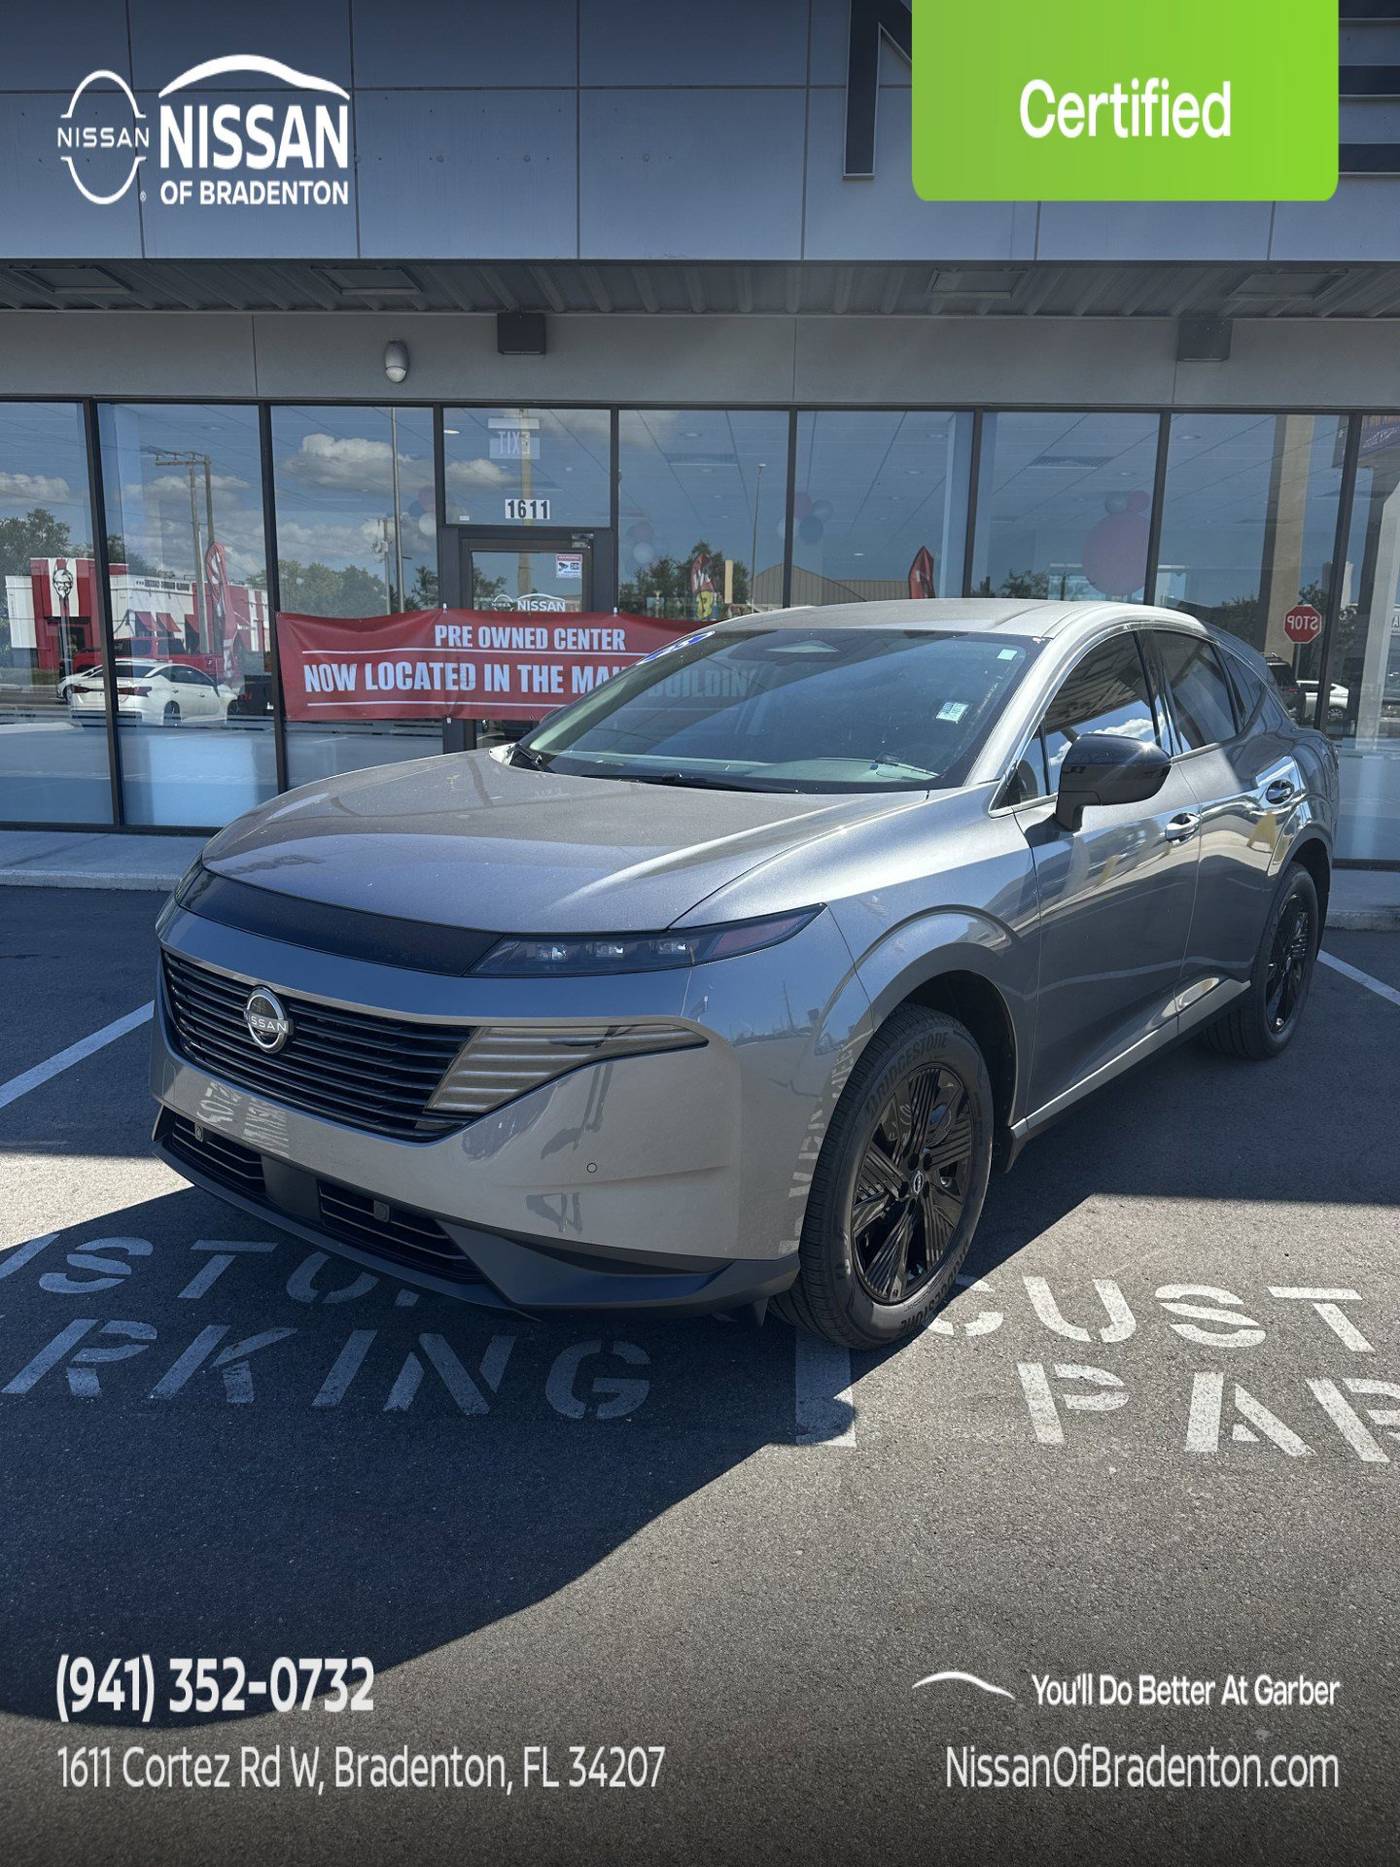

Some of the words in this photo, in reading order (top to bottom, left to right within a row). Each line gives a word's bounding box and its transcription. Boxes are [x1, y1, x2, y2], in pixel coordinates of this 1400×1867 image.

[508, 500, 547, 518] 1611
[517, 600, 566, 612] NISSAN
[434, 624, 473, 648] PRE
[478, 626, 548, 649] OWNED
[553, 628, 626, 650] CENTER
[303, 663, 358, 692] NOW
[364, 661, 476, 691] LOCATED
[484, 663, 511, 692] IN
[516, 665, 565, 693] THE
